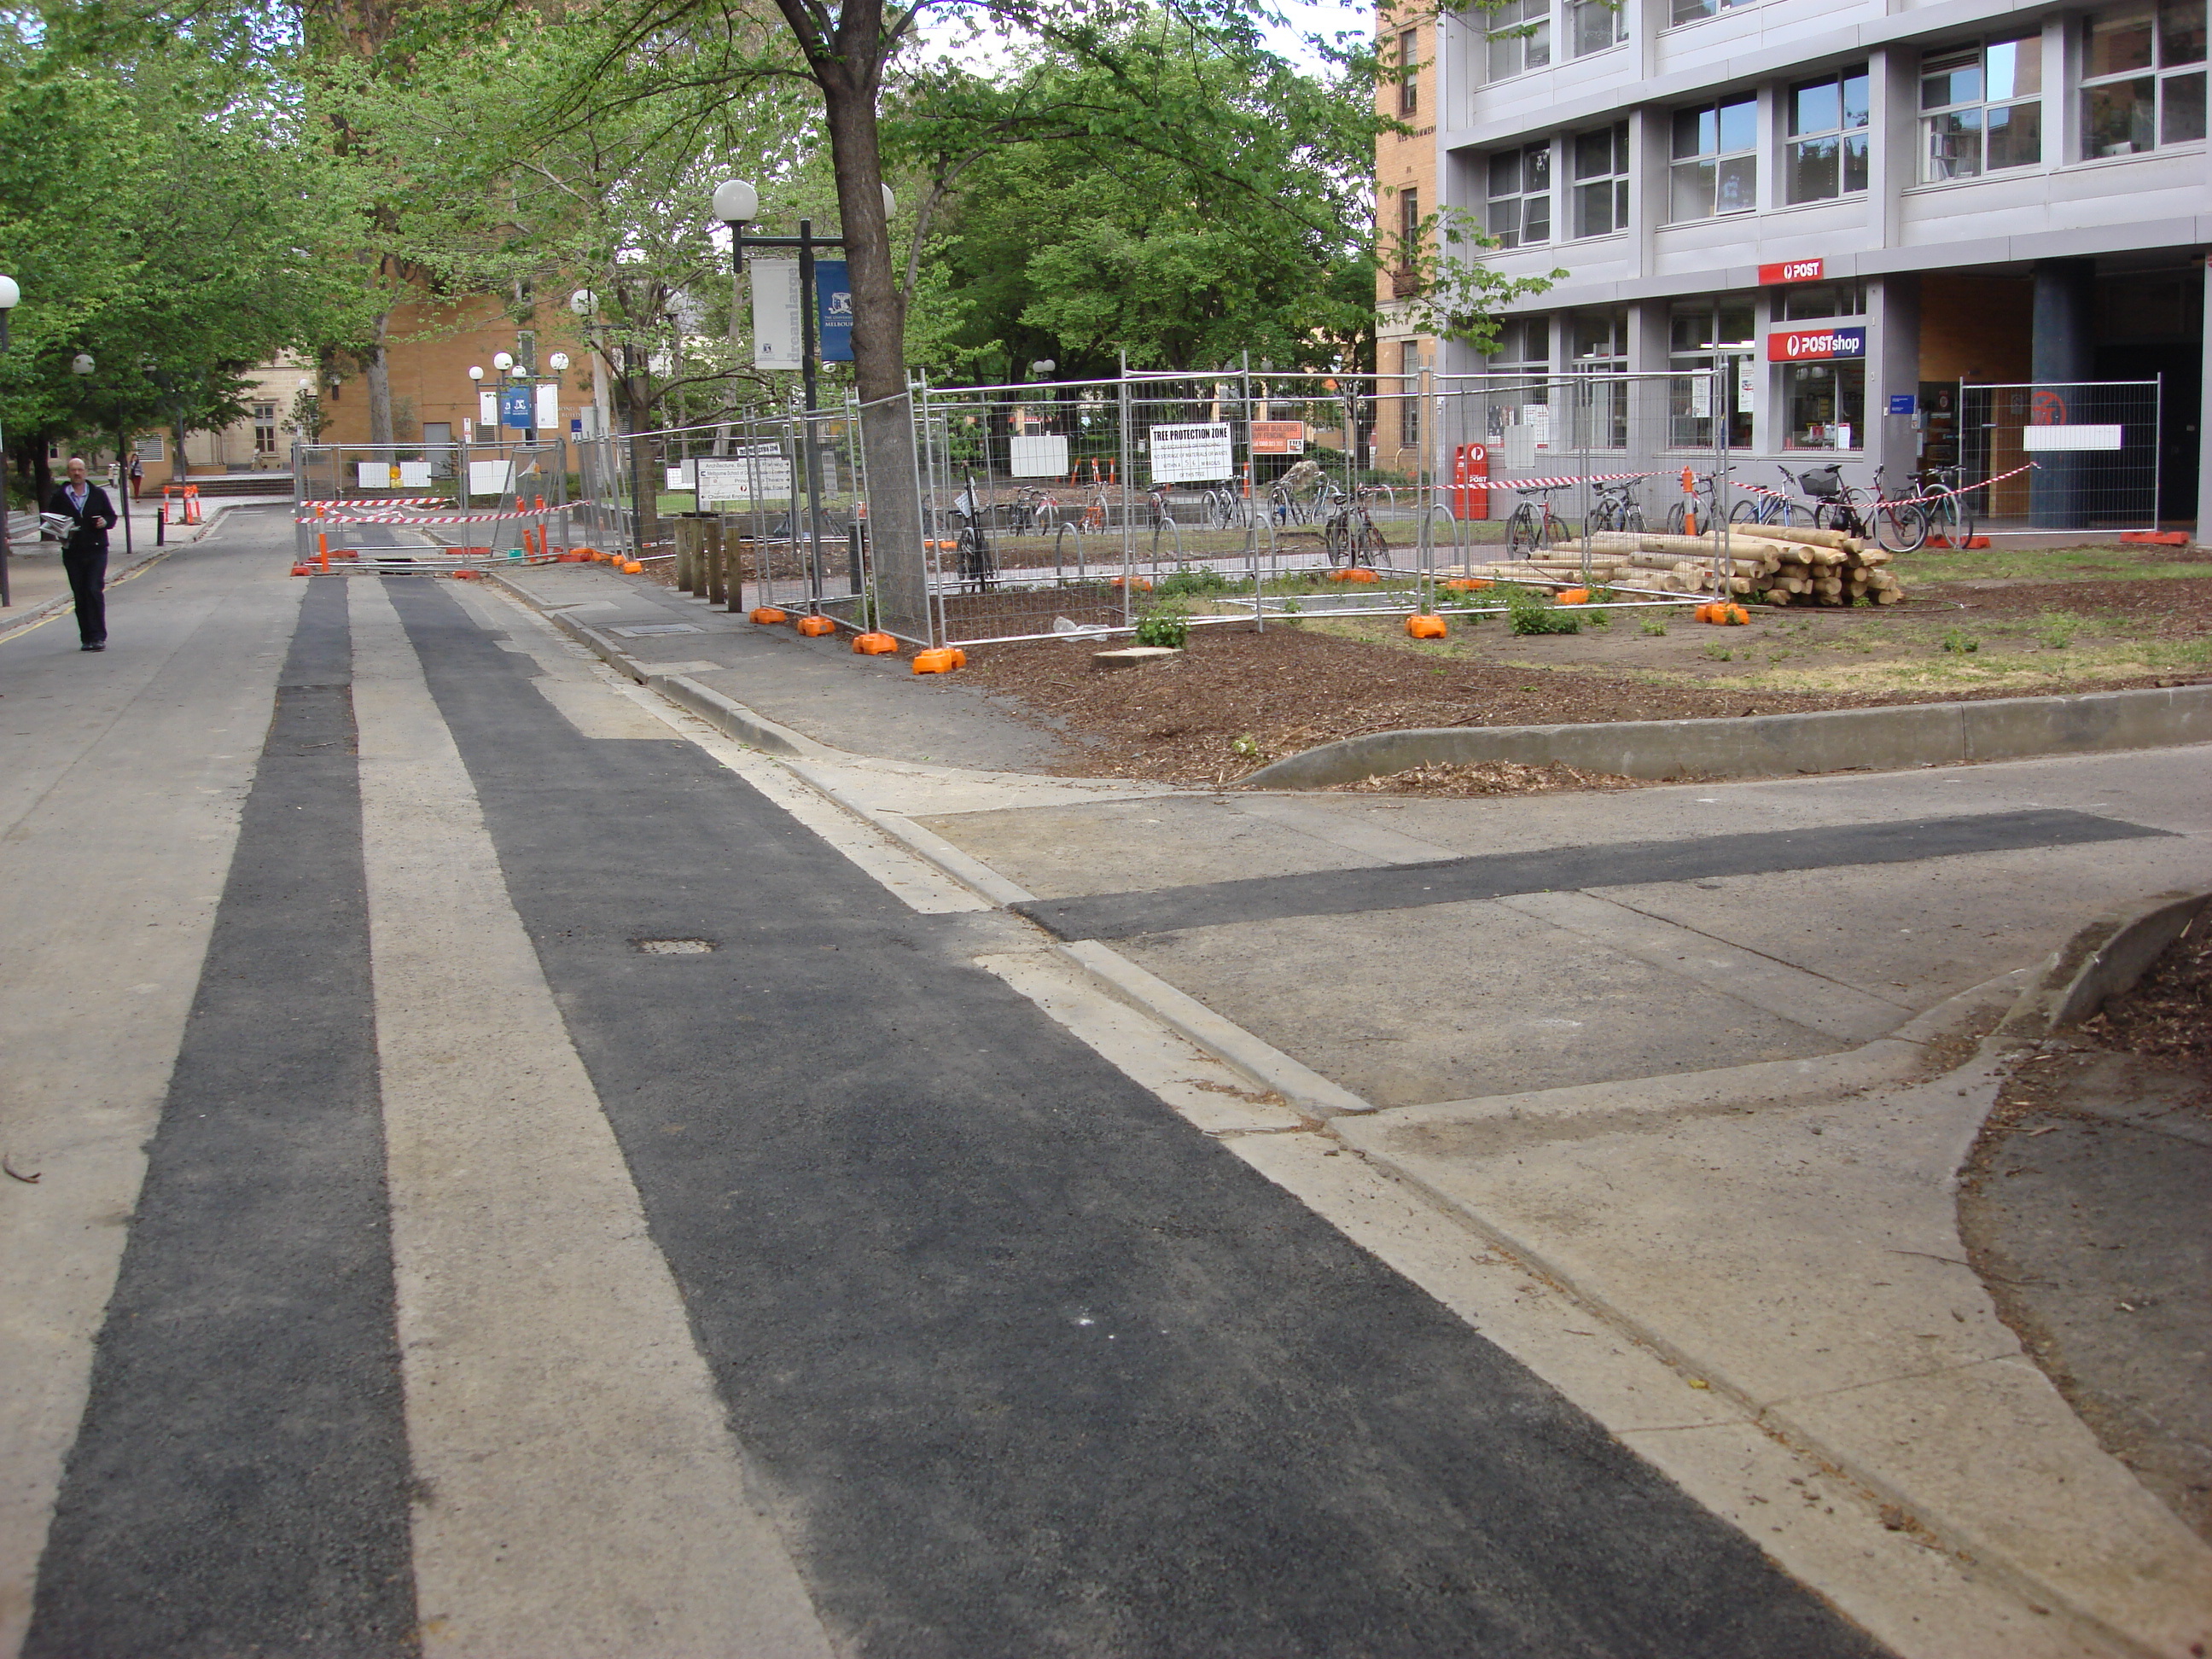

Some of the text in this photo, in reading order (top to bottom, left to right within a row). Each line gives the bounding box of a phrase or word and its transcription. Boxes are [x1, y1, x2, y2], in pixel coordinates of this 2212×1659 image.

[1412, 125, 1436, 139] OMMER
[1793, 262, 1819, 277] POST
[785, 267, 803, 363] dream large
[1802, 335, 1860, 353] POSTshop
[1153, 428, 1228, 441] TREE PROTECTION ZONE
